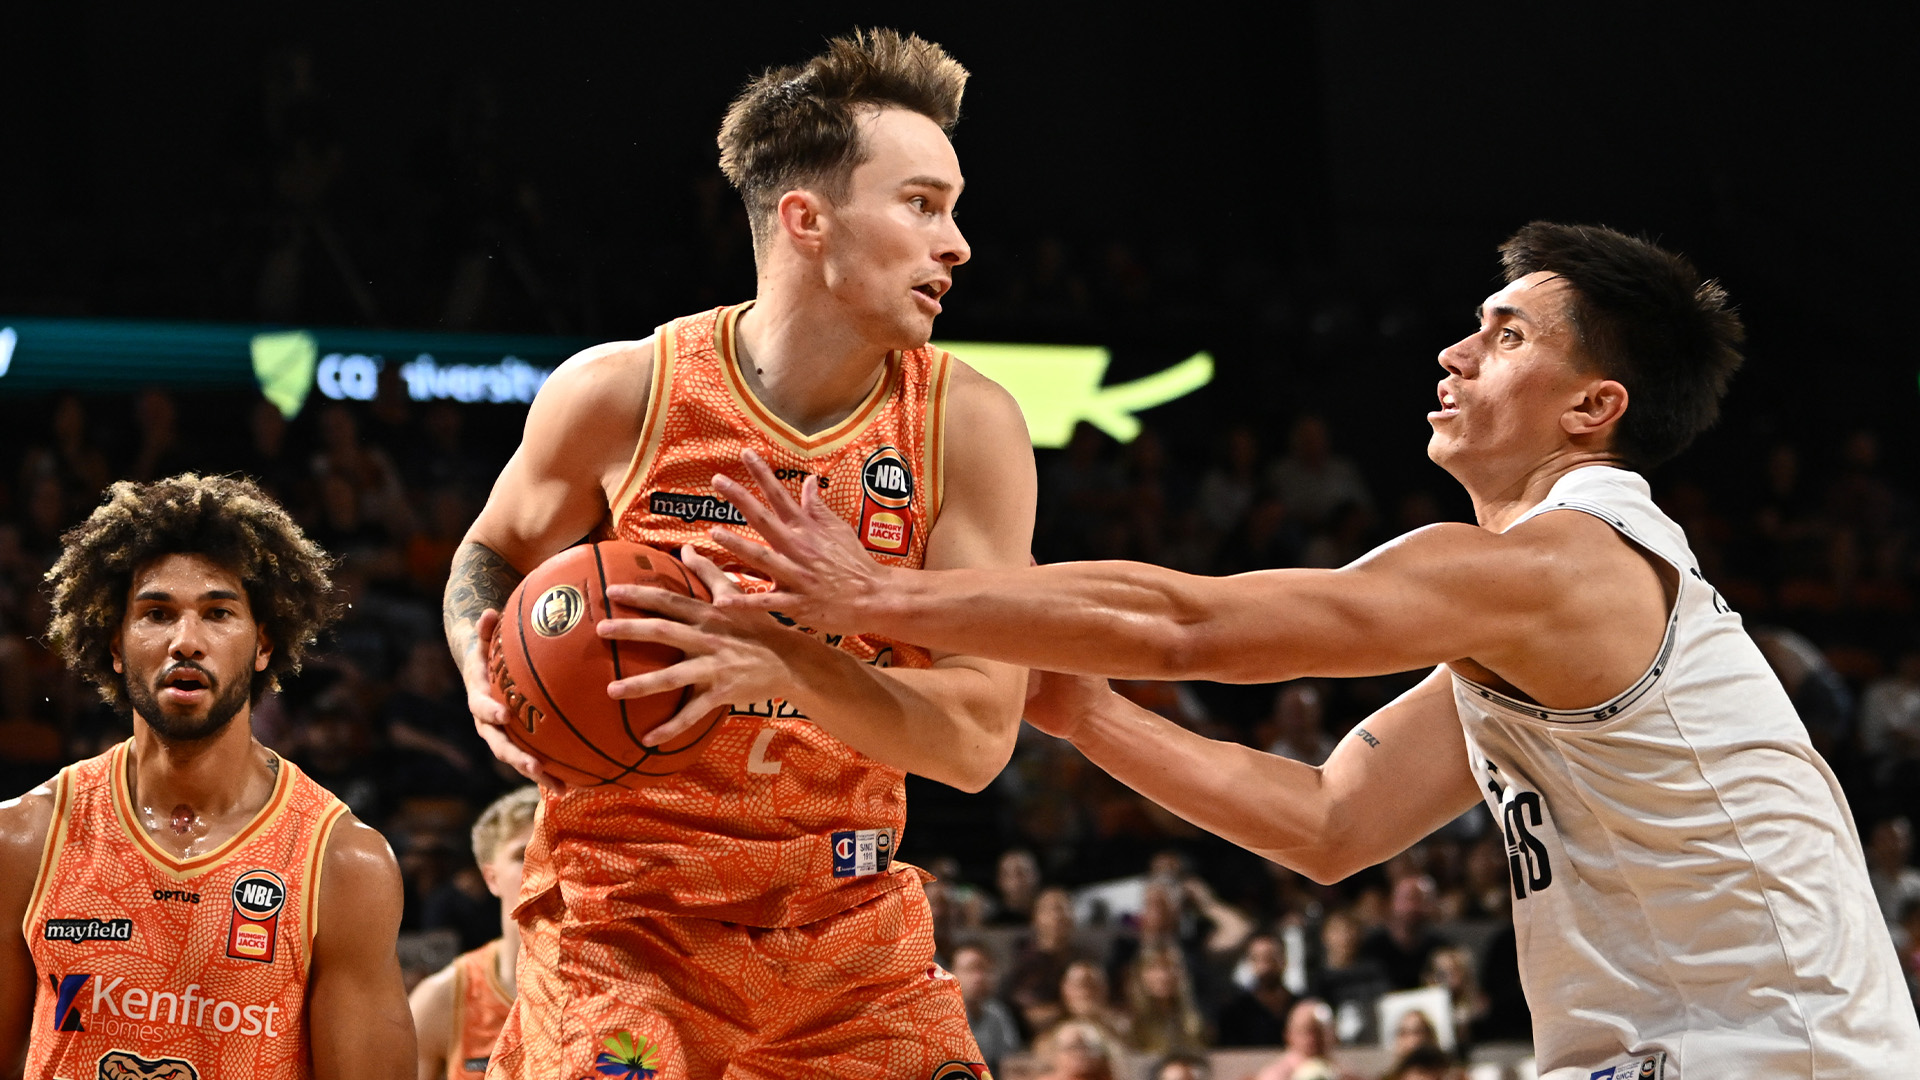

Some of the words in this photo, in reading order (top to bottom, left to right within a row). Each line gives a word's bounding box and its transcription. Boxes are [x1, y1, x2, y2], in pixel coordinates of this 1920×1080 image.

[775, 469, 830, 489] OPTS
[874, 464, 908, 493] NBL
[871, 521, 902, 532] HUNGRY
[153, 890, 200, 904] OPTUS
[242, 883, 274, 907] NBL
[47, 921, 130, 941] mayfield
[91, 975, 280, 1038] Kenfrost
[89, 1014, 164, 1043] Homes
